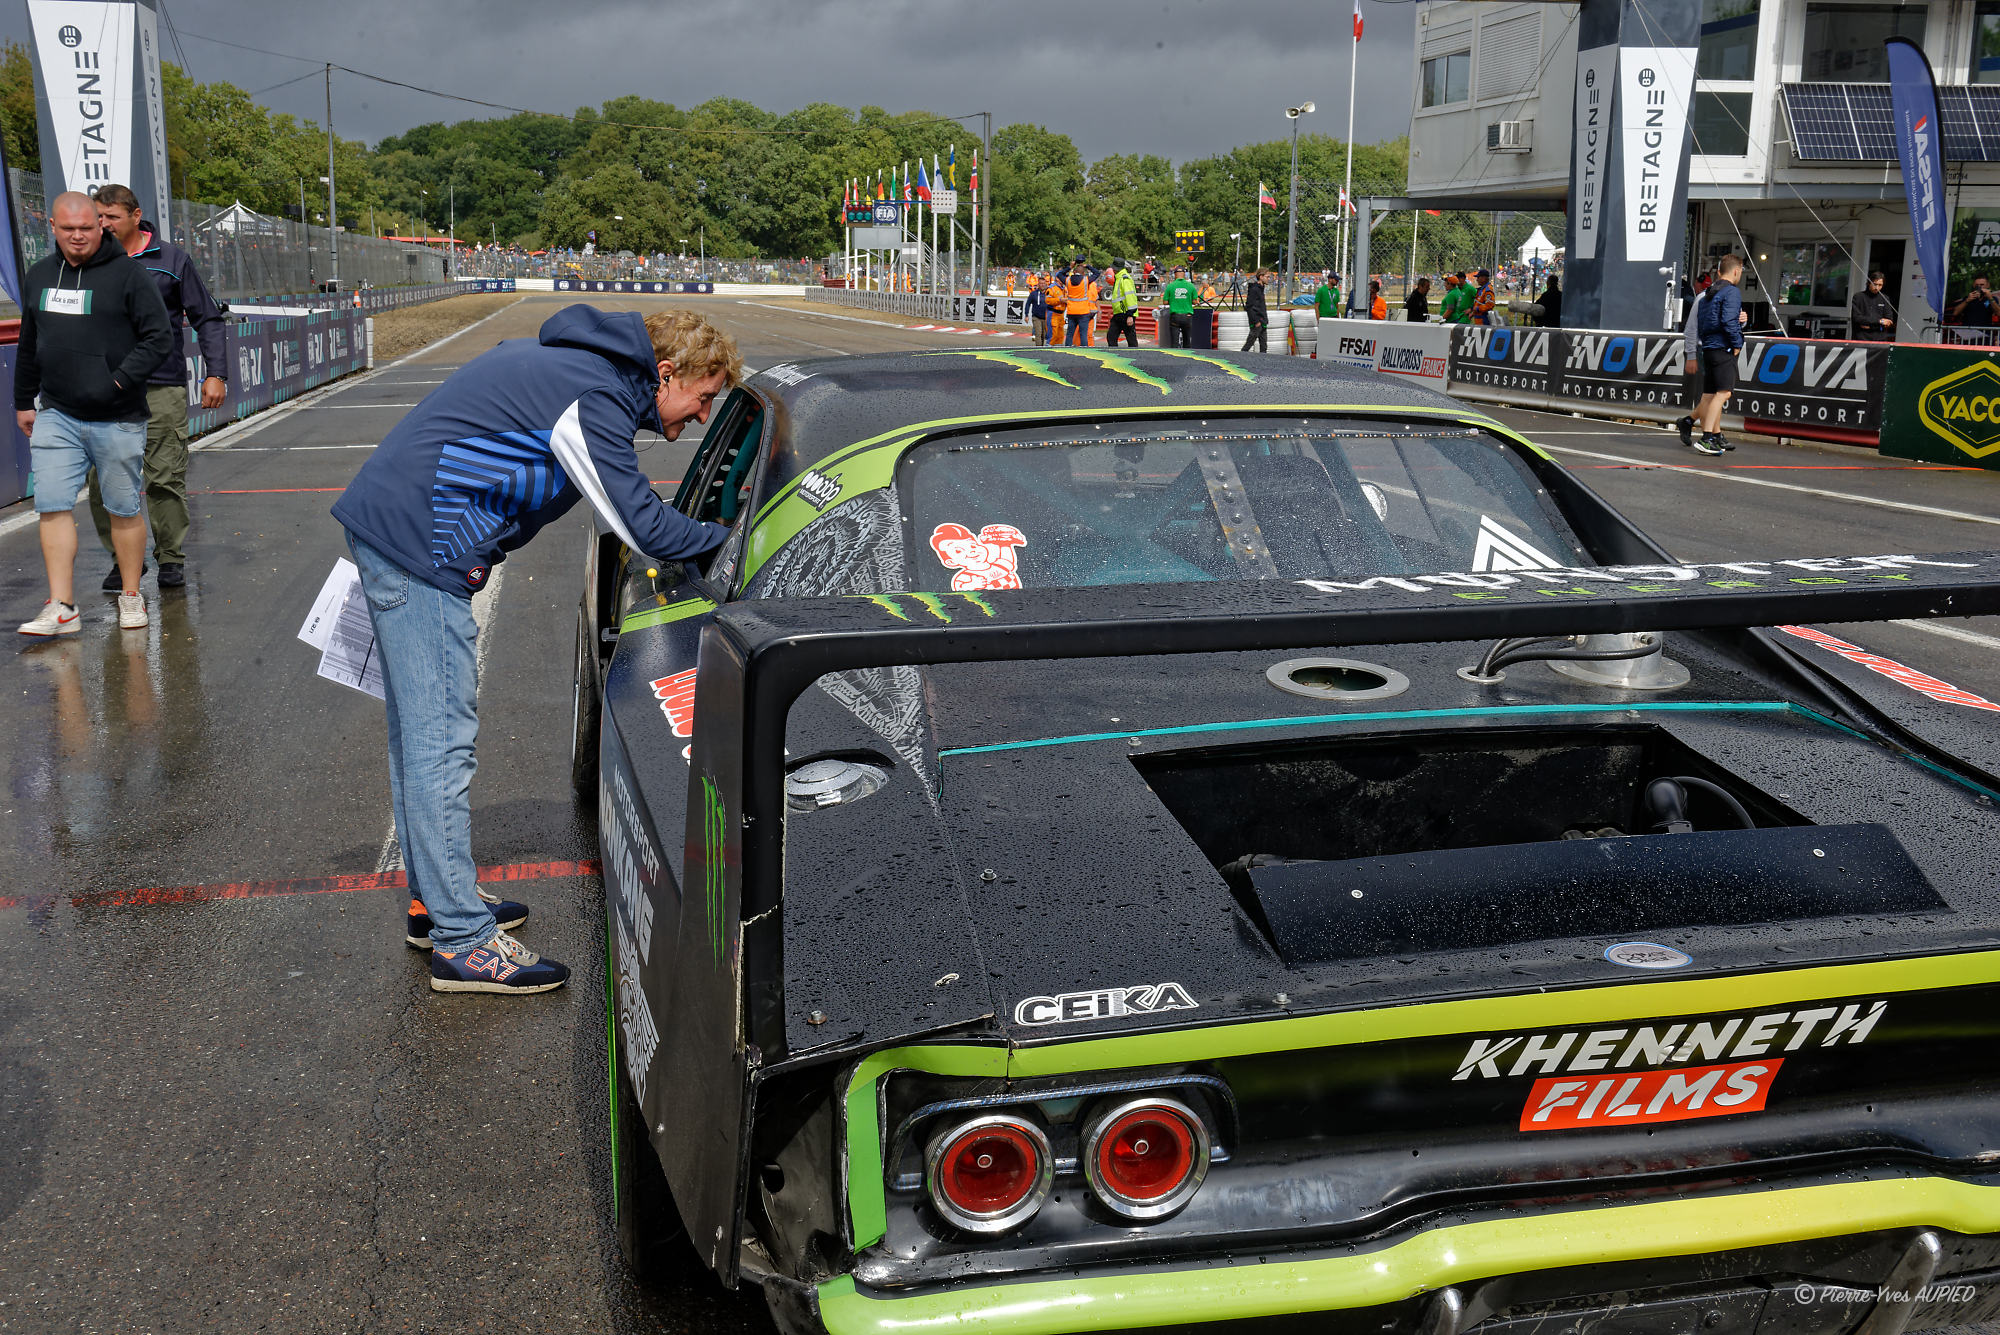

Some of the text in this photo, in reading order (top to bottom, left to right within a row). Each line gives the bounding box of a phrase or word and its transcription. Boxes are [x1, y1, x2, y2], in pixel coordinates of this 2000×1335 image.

[74, 51, 109, 197] ETAGNE
[1582, 89, 1600, 230] BRETAGNE
[1638, 90, 1665, 233] BRETAGNE
[1338, 337, 1371, 356] FFSA
[1380, 346, 1423, 371] RALLYCROSS
[1421, 358, 1446, 377] FRANCE
[1456, 369, 1548, 391] MOTORSPORT
[1562, 383, 1683, 405] MOTORSPORT
[1722, 398, 1866, 424] OTORSPORT
[1452, 574, 1913, 600] ENERGY
[614, 763, 660, 887] MOTORSPORT
[464, 948, 520, 982] EA7
[1451, 1000, 1888, 1082] KHENNETH
[1532, 1066, 1769, 1123] FILMS
